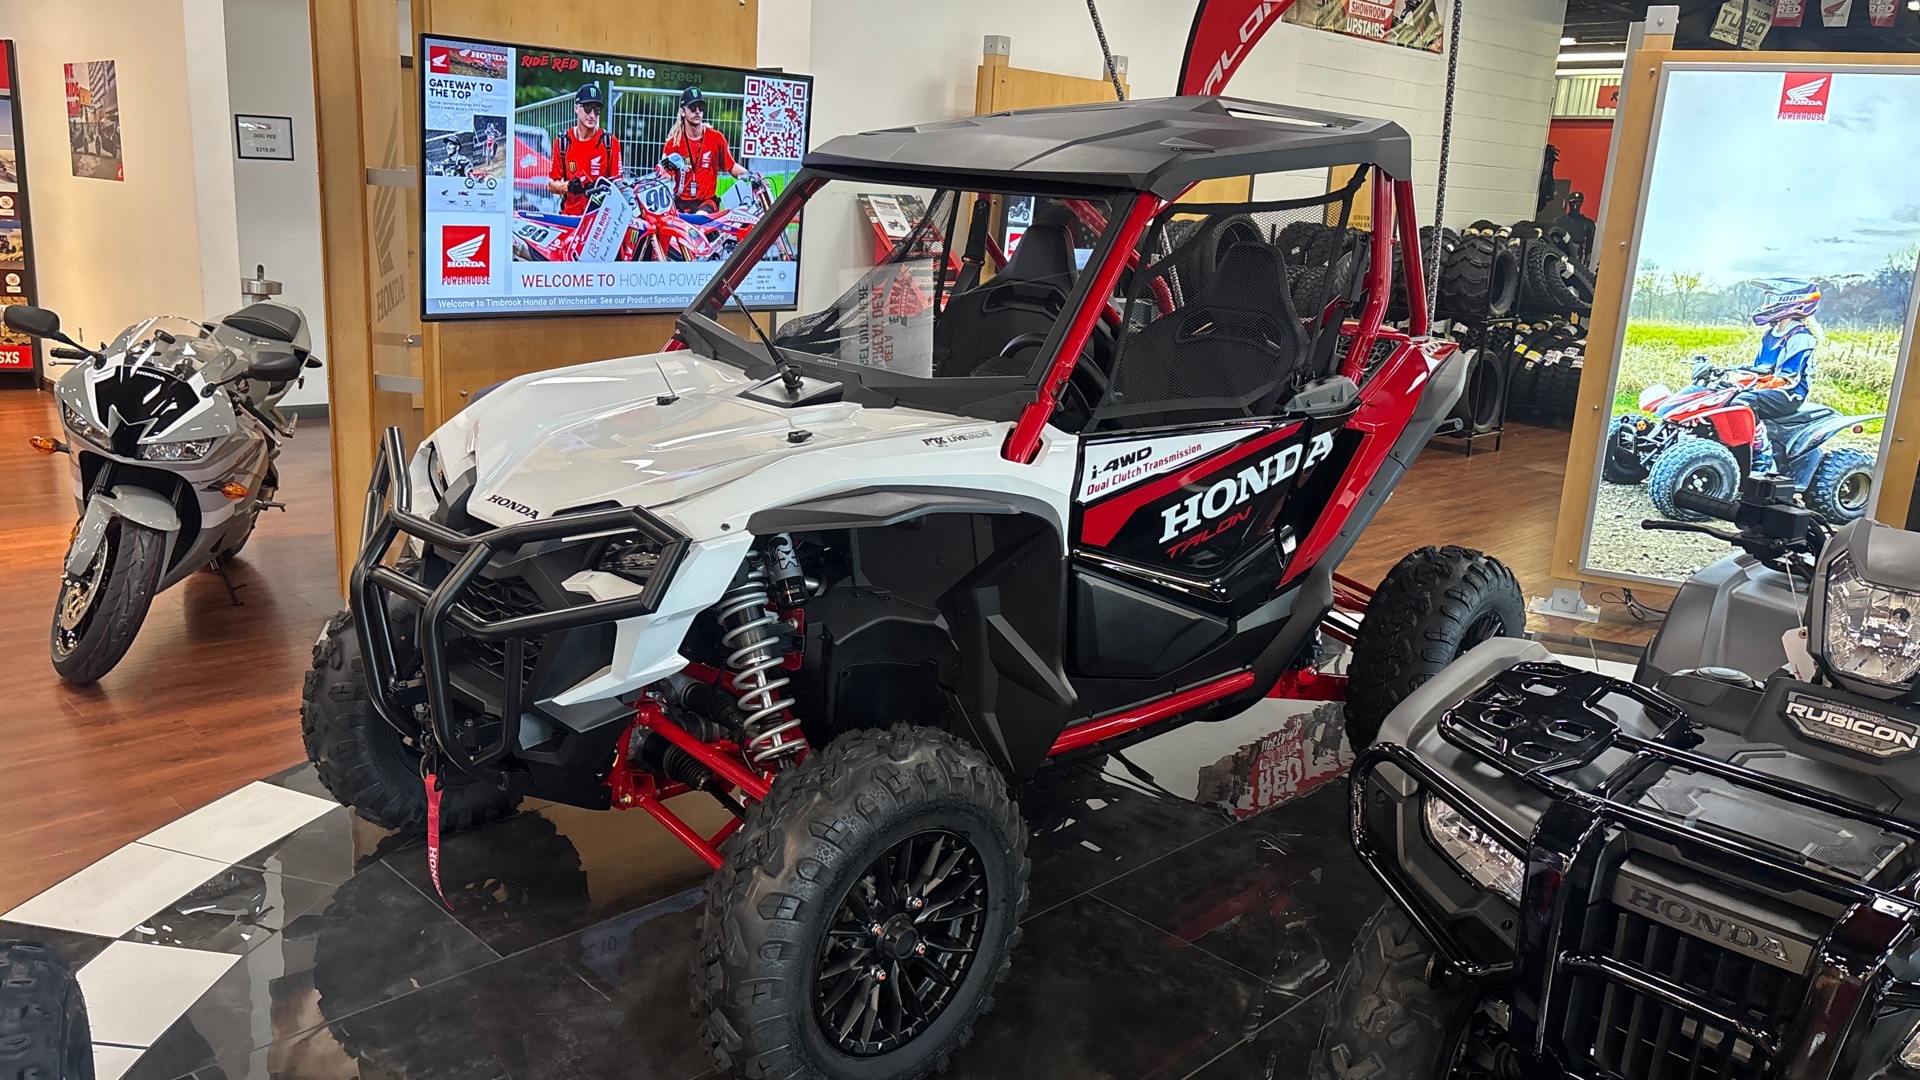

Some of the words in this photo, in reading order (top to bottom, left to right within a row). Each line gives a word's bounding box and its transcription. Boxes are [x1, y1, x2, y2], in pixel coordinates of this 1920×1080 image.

[1351, 1, 1386, 20] SHOWROOM
[1776, 4, 1801, 14] RED
[1869, 4, 1895, 14] RED
[1346, 16, 1385, 39] UPSTAIRS
[520, 55, 549, 69] RIDE
[552, 57, 579, 72] RED
[582, 58, 623, 77] Make
[627, 63, 656, 79] The
[659, 67, 703, 84] Green
[66, 82, 80, 98] RIDE
[429, 78, 477, 91] GATEWAY
[479, 82, 493, 92] TO
[429, 88, 449, 98] THE
[451, 90, 471, 99] TOP
[1777, 112, 1825, 121] POWERHOUSE
[646, 184, 671, 213] 90
[518, 224, 549, 243] 90
[442, 276, 490, 286] POWERHOUSE
[521, 274, 594, 288] WELCOME
[597, 274, 615, 287] TO
[619, 274, 666, 287] HONDA
[376, 274, 406, 323] HONDA
[438, 300, 474, 308] Welcome
[476, 299, 484, 308] to
[486, 298, 522, 307] Timbrook
[524, 298, 547, 306] Honda
[549, 297, 558, 306] of
[558, 296, 598, 306] Winchester.
[600, 296, 612, 305] See
[627, 296, 652, 304] Product
[762, 293, 784, 302] Anthony
[136, 370, 166, 382] HONDA
[1087, 478, 1110, 496] Dual
[1112, 466, 1142, 486] Clutch
[1143, 444, 1202, 472] Transmission
[1091, 446, 1152, 480] i-4WD
[1158, 431, 1335, 544] HONDA
[486, 494, 540, 520] HONDA
[1166, 506, 1252, 560] TALON
[1786, 702, 1919, 749] RUBICON
[1814, 732, 1858, 748] AUTOMATIC
[1626, 884, 1792, 965] HONDA
